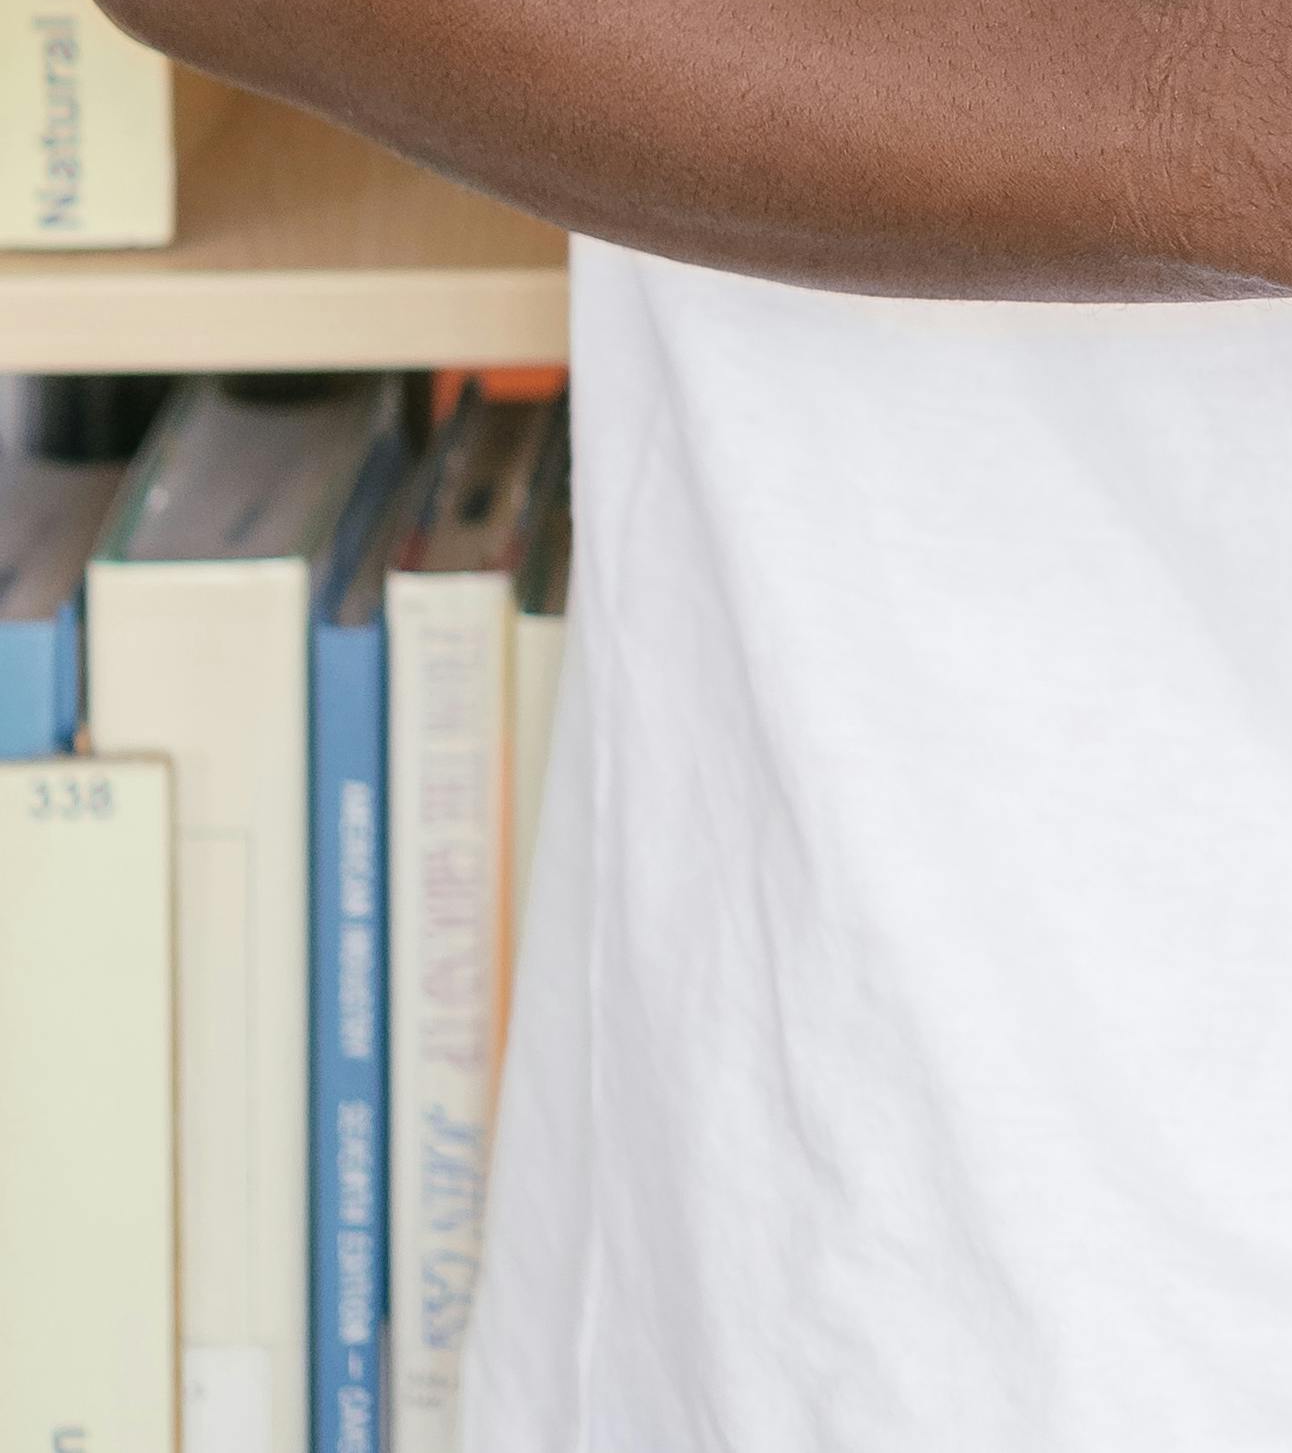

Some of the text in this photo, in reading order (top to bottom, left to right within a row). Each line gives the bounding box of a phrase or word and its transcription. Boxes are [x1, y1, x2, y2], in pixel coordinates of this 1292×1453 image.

[33, 18, 81, 231] Natural
[27, 777, 114, 821] 338
[338, 778, 374, 1345] AMERICAN INDUSTRY SEVENTH EDITION
